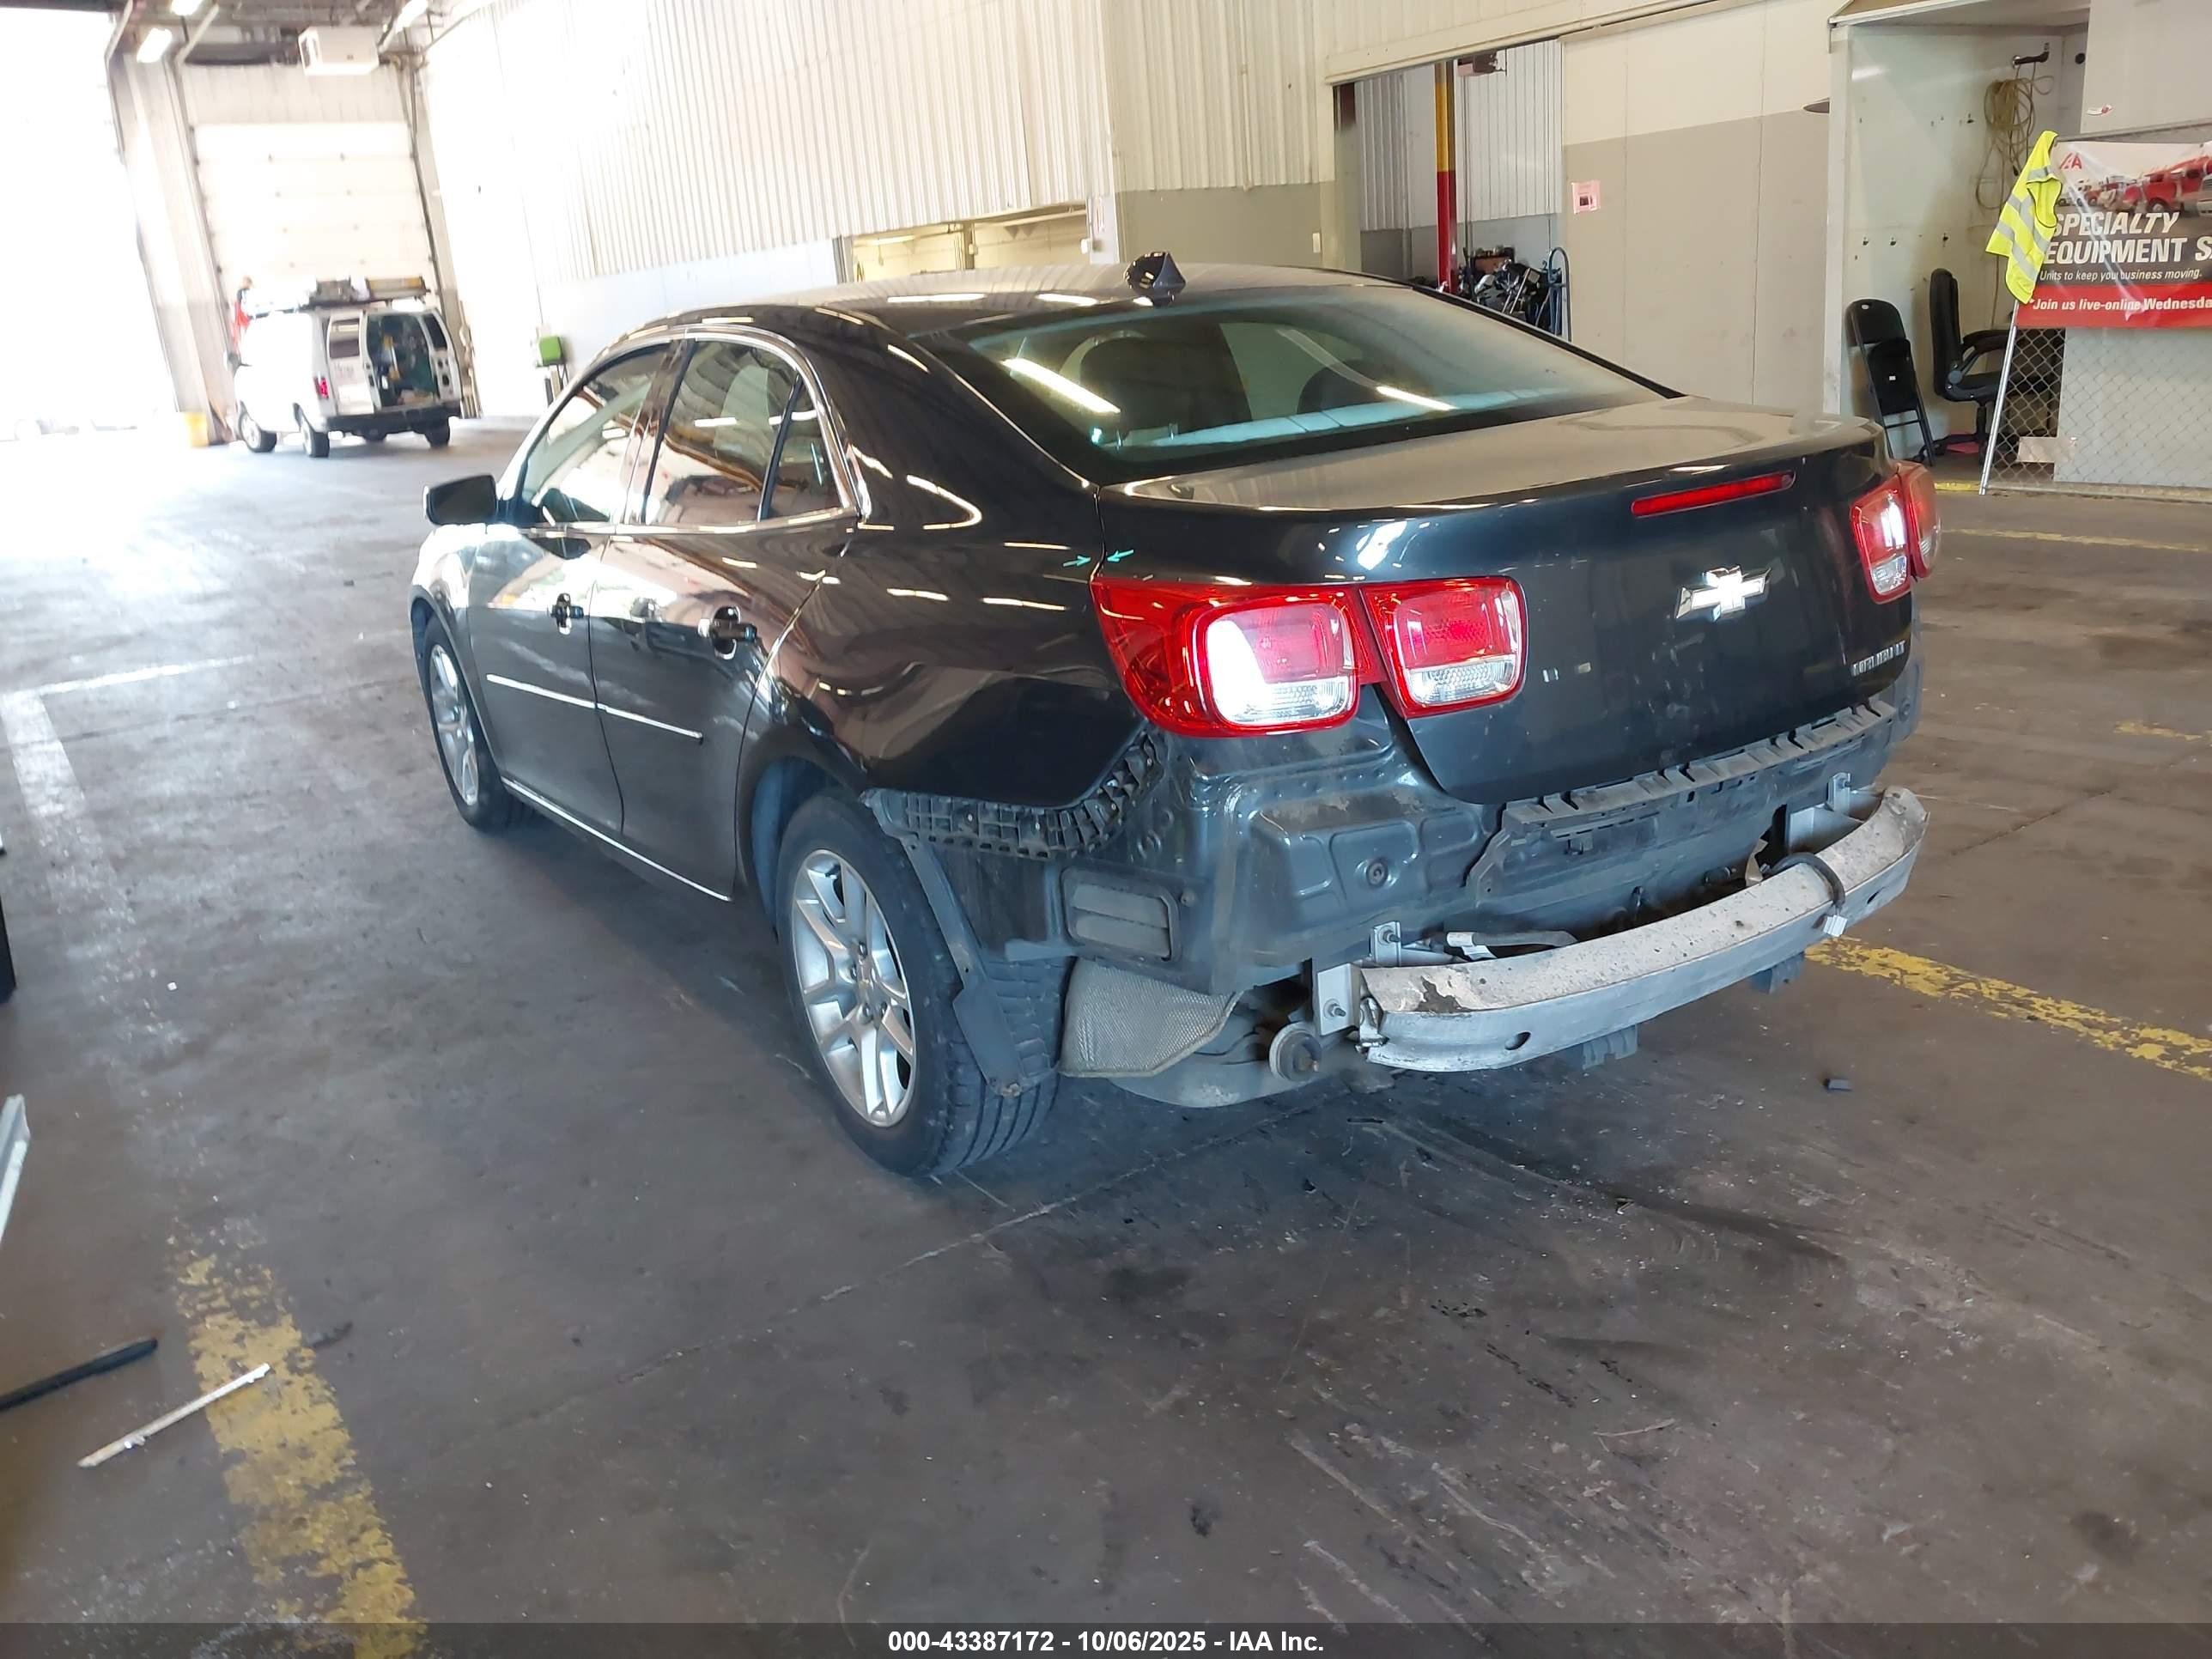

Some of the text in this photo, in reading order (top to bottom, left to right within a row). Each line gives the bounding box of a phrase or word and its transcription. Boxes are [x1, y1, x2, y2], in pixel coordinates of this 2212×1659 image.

[2052, 211, 2179, 237] SPECIALTY
[2042, 235, 2212, 265] EQUIPMENT S
[2039, 267, 2203, 283] Units to keep your business moving.
[2062, 301, 2075, 310] us
[2079, 298, 2142, 310] live-online
